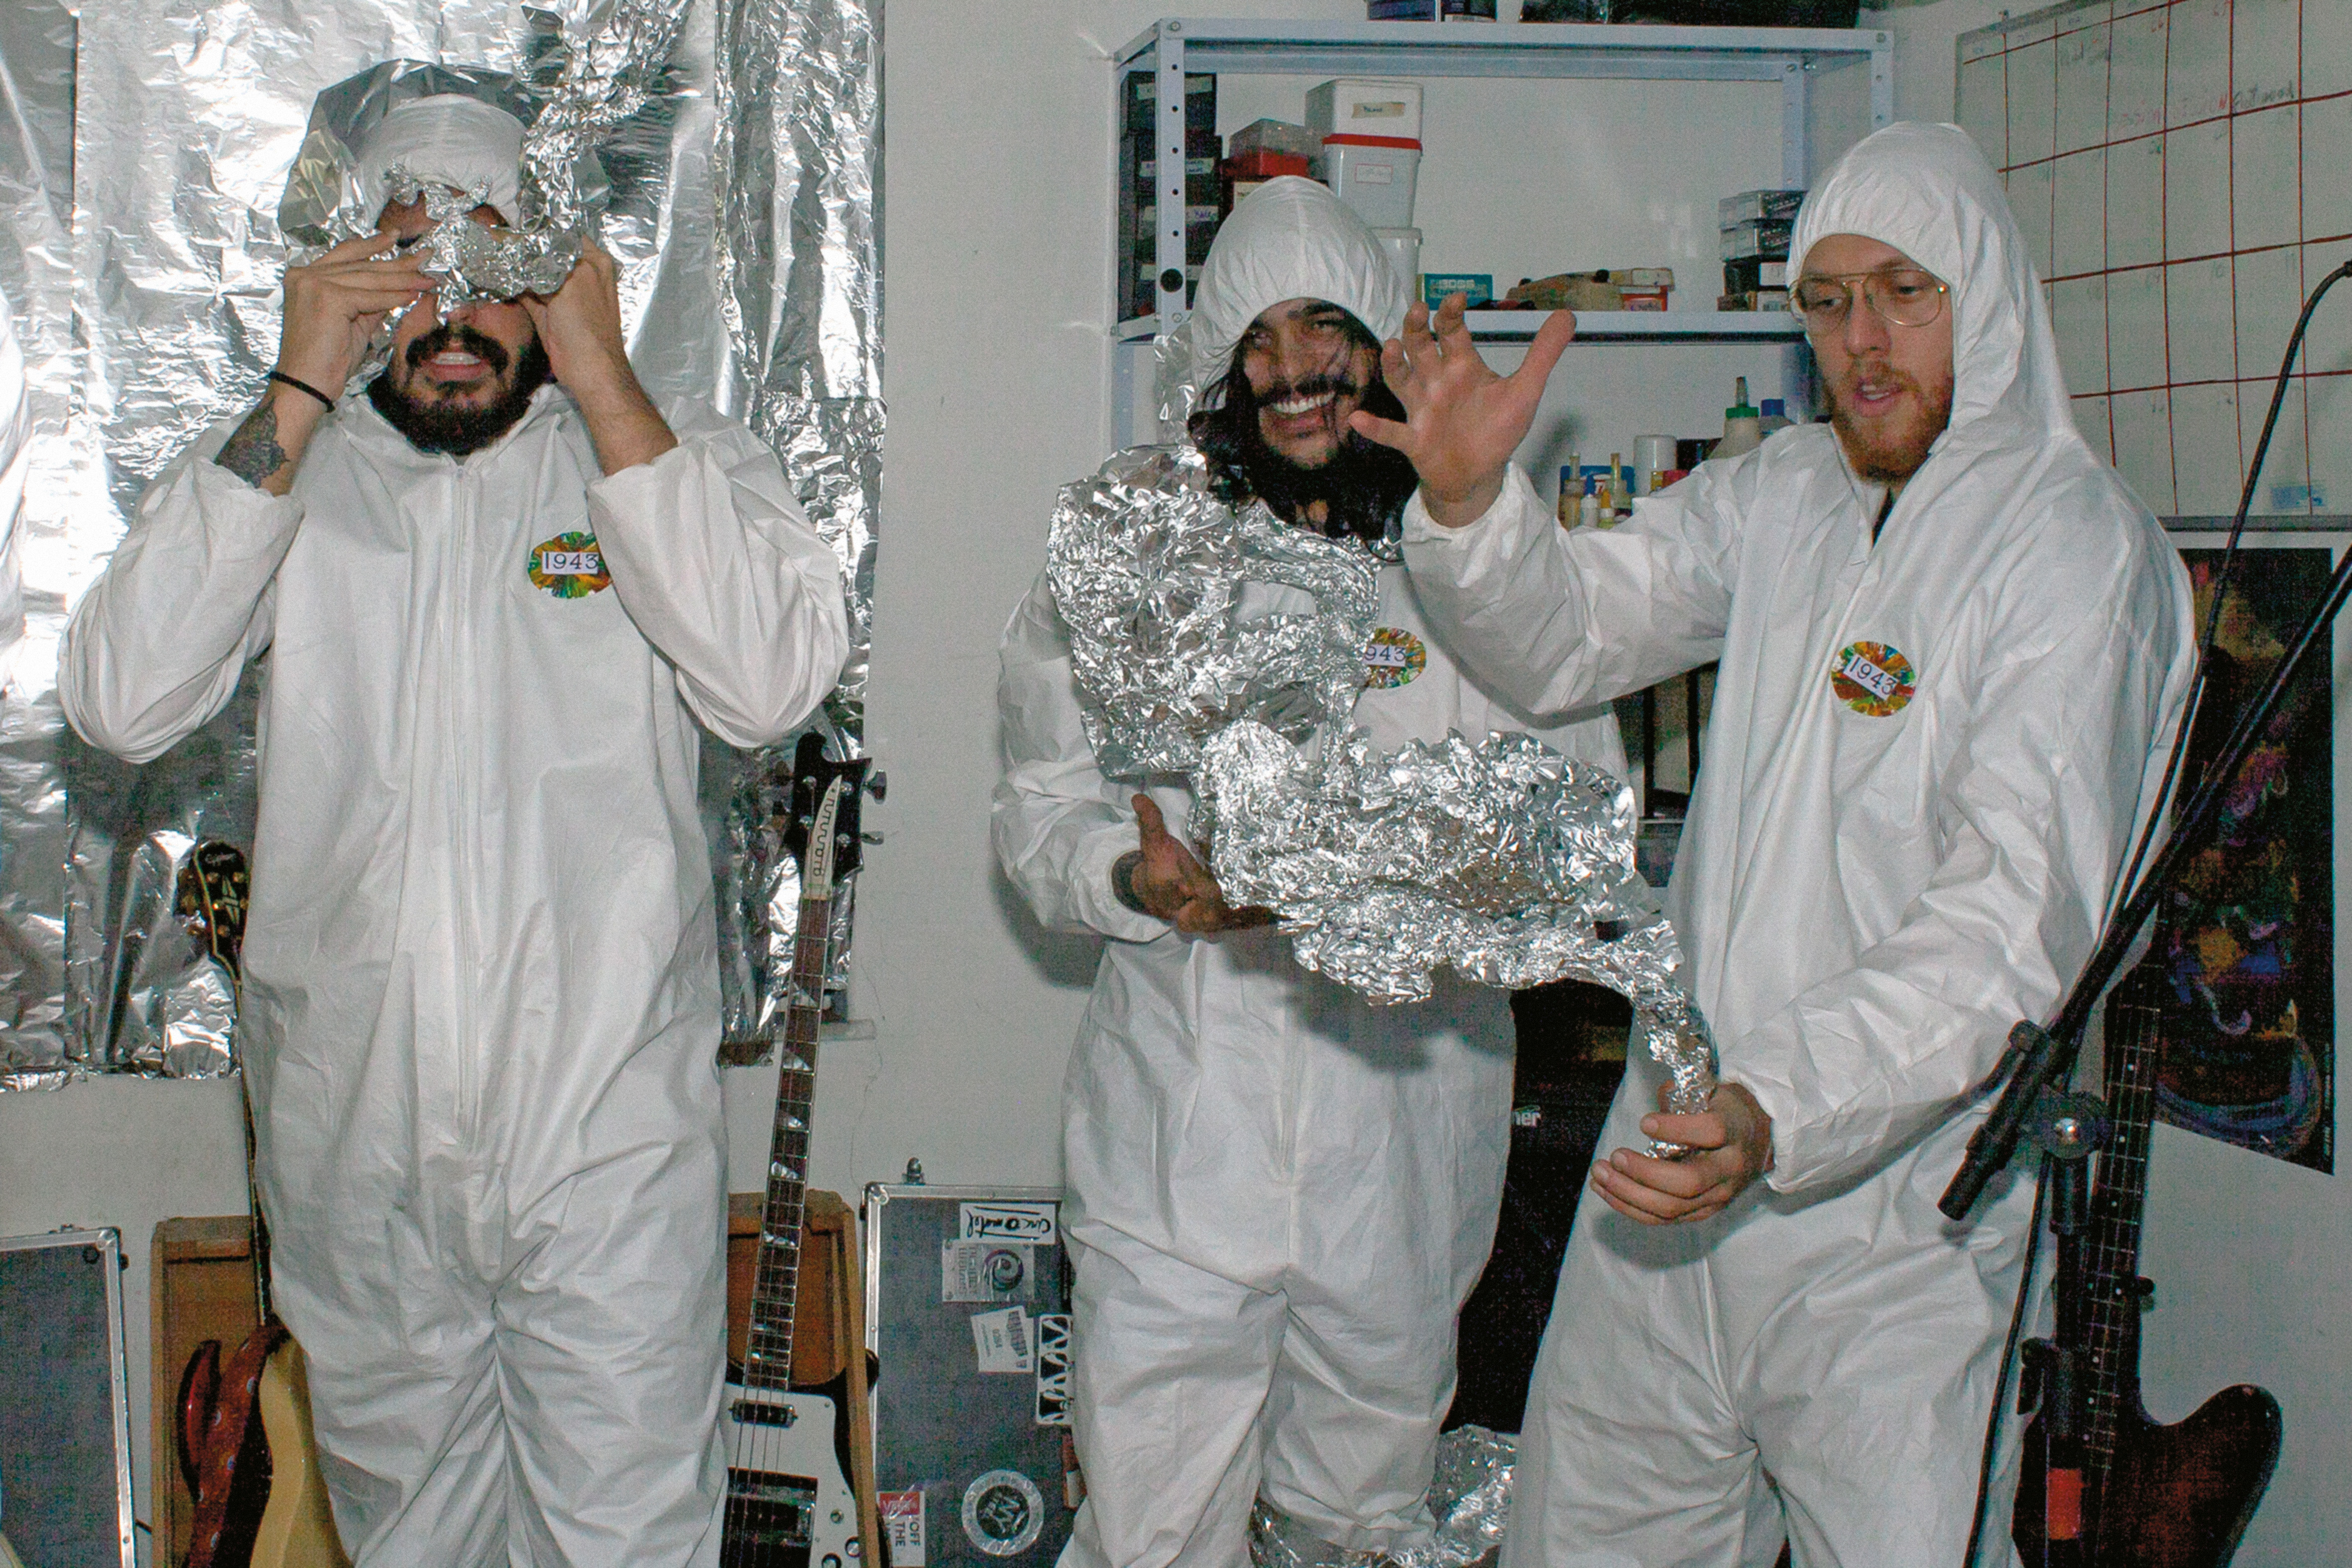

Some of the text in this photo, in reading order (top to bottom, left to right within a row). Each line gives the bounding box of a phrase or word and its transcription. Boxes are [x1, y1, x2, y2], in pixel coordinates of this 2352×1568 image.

[545, 553, 599, 569] 1943
[1364, 645, 1407, 662] 943
[1849, 656, 1897, 695] 1943
[895, 1522, 906, 1547] THE
